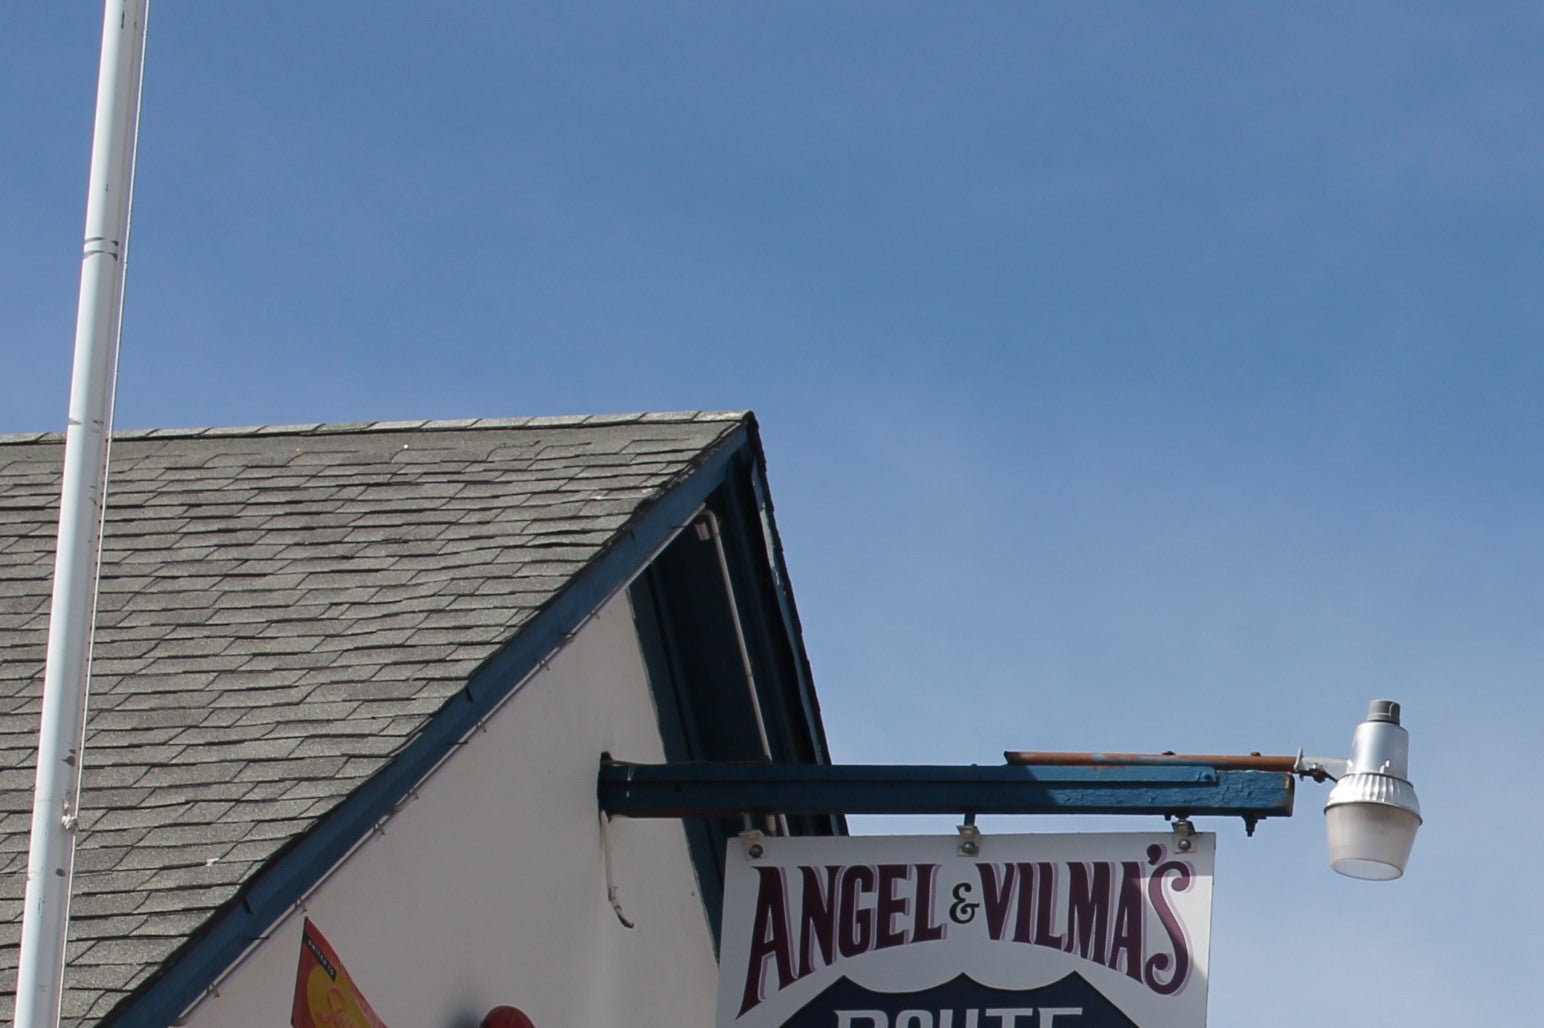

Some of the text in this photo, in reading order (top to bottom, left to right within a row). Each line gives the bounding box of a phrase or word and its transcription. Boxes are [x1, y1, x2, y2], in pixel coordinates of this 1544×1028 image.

[735, 843, 1197, 1020] ANGEL & VILMA'S
